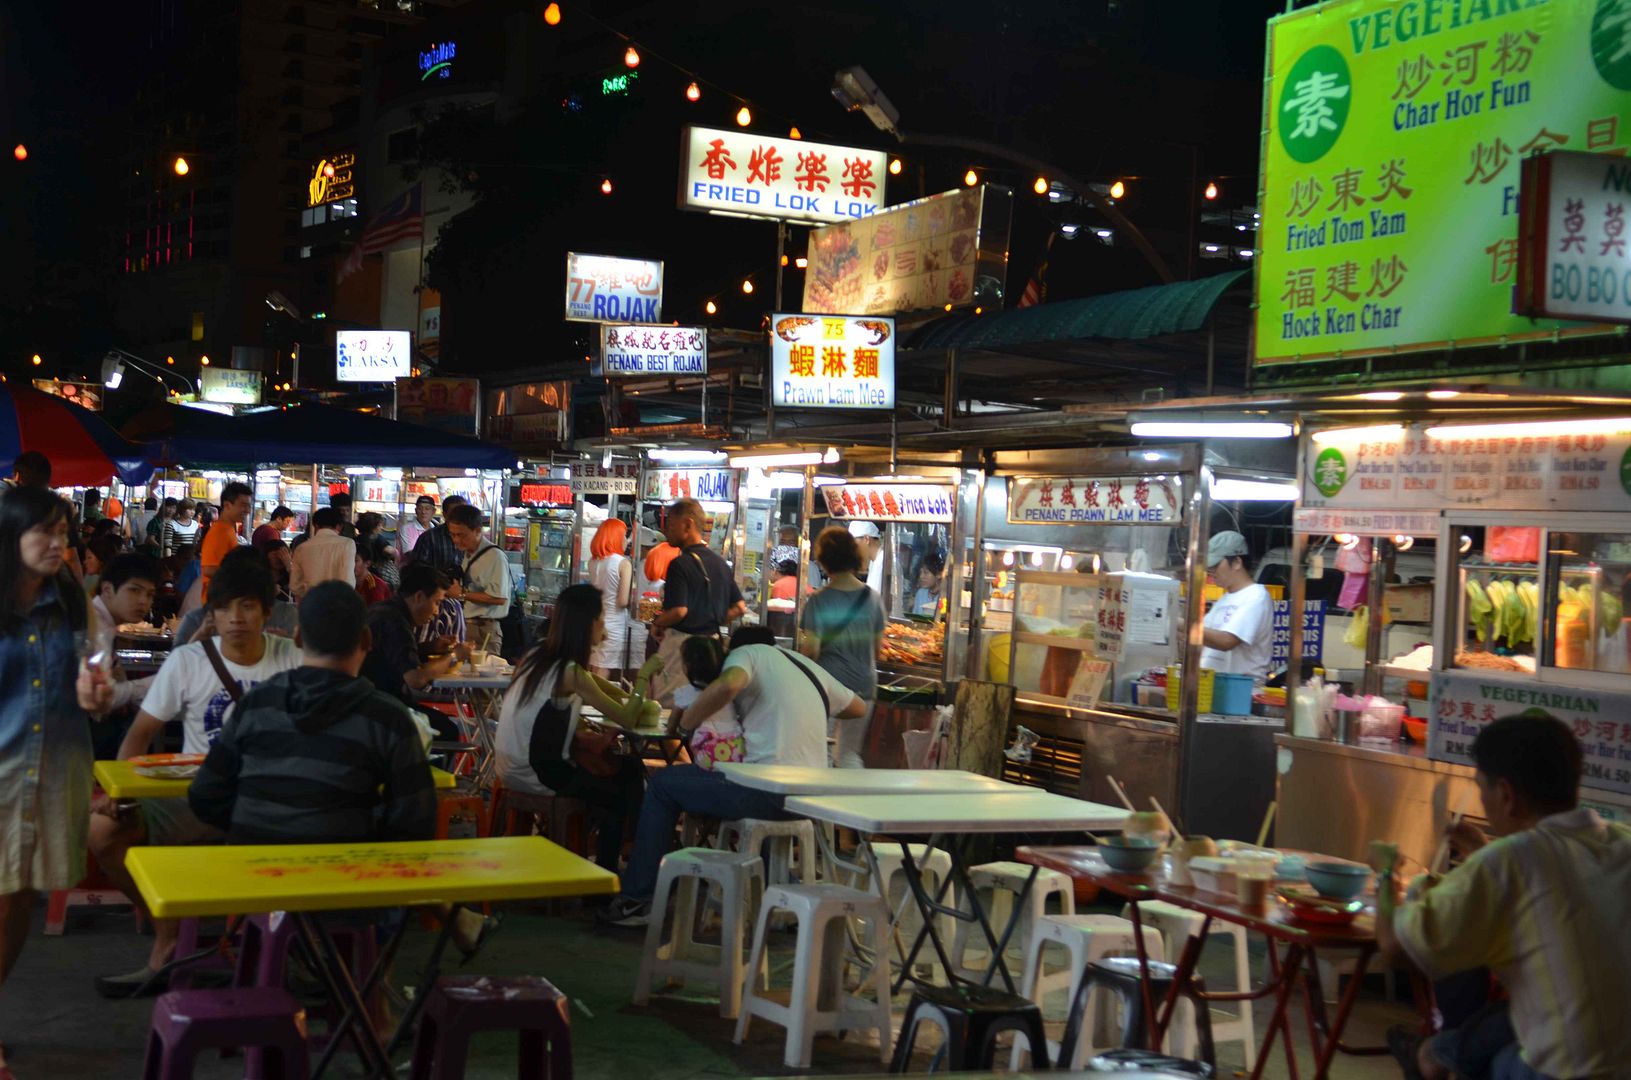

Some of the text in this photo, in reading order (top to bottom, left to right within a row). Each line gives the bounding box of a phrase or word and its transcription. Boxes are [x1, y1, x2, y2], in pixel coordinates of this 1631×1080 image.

[1391, 29, 1541, 102] 炒河粉
[1284, 71, 1350, 139] 素
[1394, 79, 1531, 132] Char Hor Fun
[693, 182, 761, 205] FRIED
[775, 193, 822, 213] LOK
[834, 201, 879, 219] LOK
[1286, 209, 1406, 252] Fried Tom Yam
[570, 278, 596, 303] 77
[1281, 254, 1408, 310] 福建炒
[1551, 263, 1582, 302] BO
[1587, 266, 1617, 304] BO
[593, 294, 658, 323] ROJAK
[1282, 304, 1402, 340] Hock Ken Char
[825, 322, 844, 337] 75
[608, 354, 703, 372] PENANG BEST ROJAK
[783, 380, 886, 405] Prawn Lam Mee
[584, 481, 608, 491] KACANG
[697, 472, 729, 498] ROJAK
[1317, 457, 1345, 488] 素
[1025, 508, 1163, 521] PENANG PRAWN LAM MEE
[1480, 685, 1600, 712] VEGETARIAN
